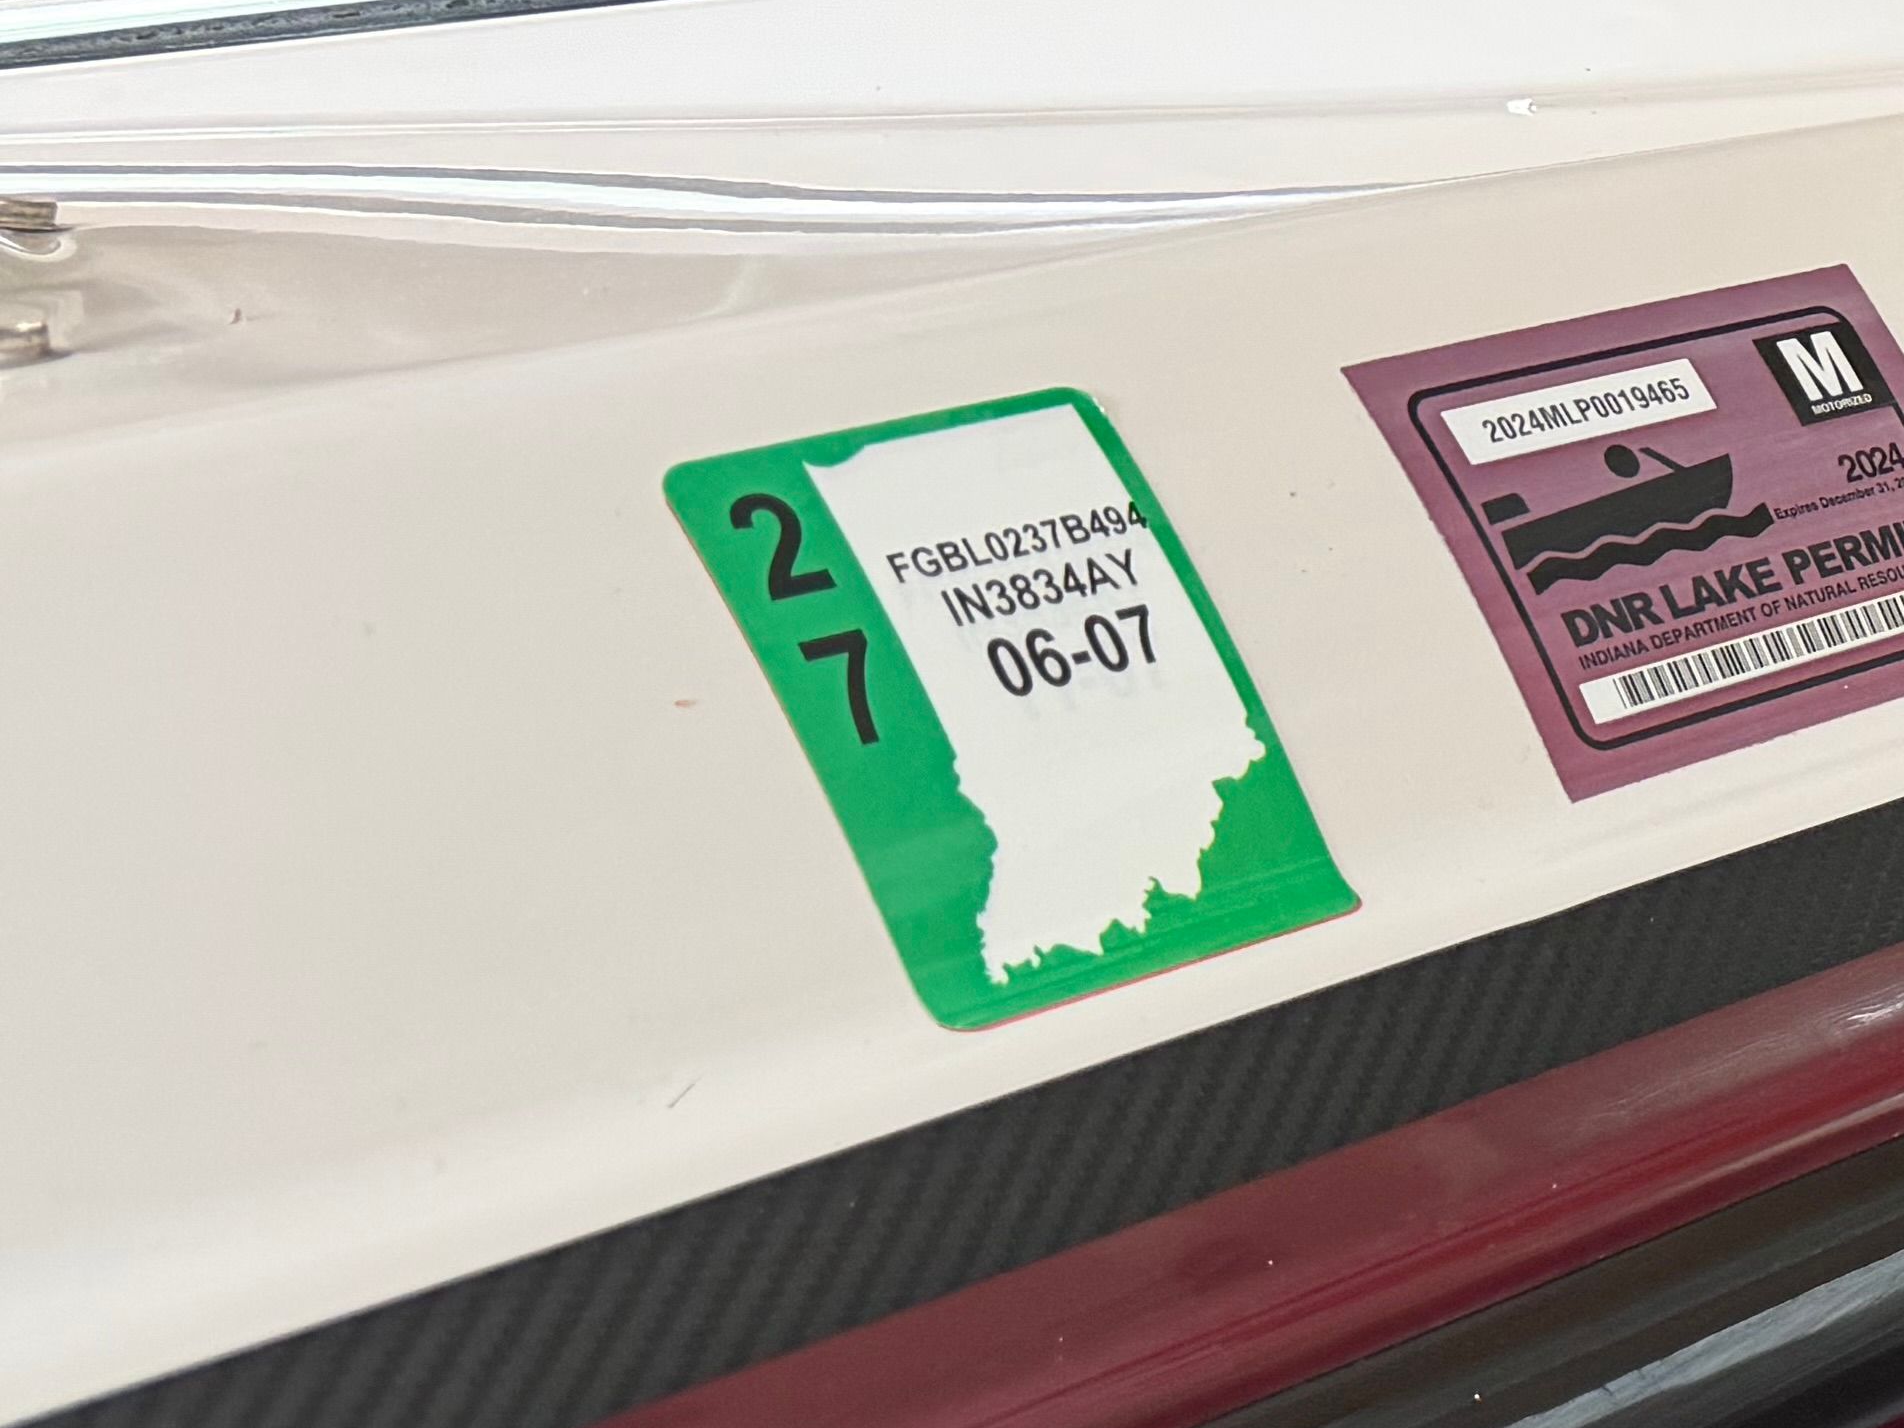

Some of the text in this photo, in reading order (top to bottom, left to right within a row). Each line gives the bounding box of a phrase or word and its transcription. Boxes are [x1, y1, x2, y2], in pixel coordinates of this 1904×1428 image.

[1776, 330, 1864, 401] M
[1481, 376, 1690, 445] 2024MLP0019465
[886, 500, 1148, 585] FGBL0237B494
[1774, 501, 1818, 520] Expires
[1819, 486, 1875, 509] December
[942, 548, 1139, 626] IN3834AY
[1561, 590, 1664, 647] DNR
[1659, 557, 1782, 620] LAKE
[1579, 640, 1649, 670] INDIANA
[1652, 610, 1759, 650] DEPARTMENT
[1761, 601, 1784, 618] OF
[1786, 578, 1856, 611] NATURAL
[986, 604, 1157, 697] 06-07
